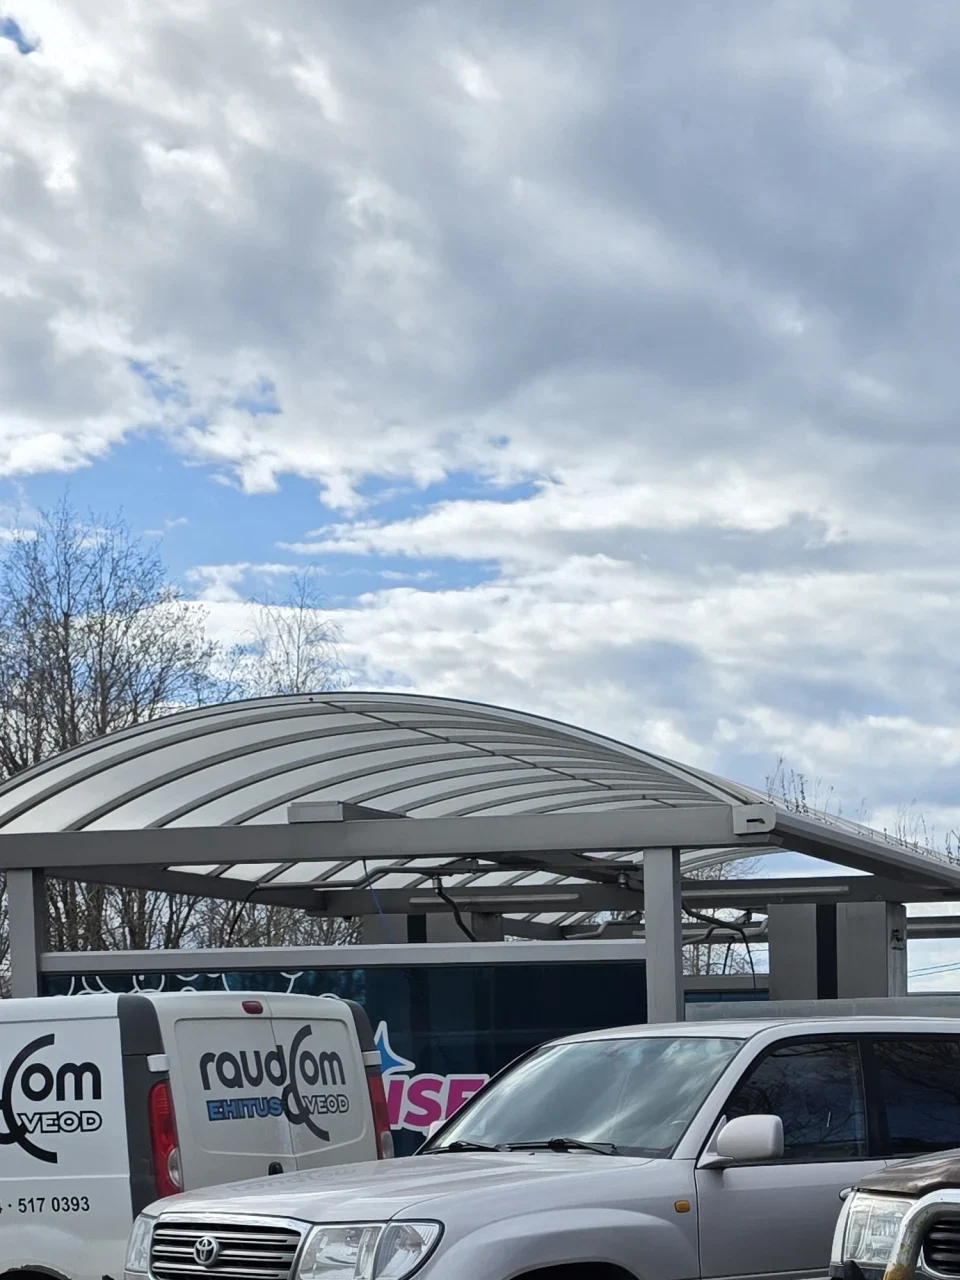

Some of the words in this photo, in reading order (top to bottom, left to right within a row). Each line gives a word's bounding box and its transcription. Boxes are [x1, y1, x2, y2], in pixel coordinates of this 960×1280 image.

[302, 1094, 349, 1115] VEOD
[16, 1110, 103, 1134] VEOD
[18, 1197, 46, 1213] 517
[51, 1196, 90, 1212] 0393
